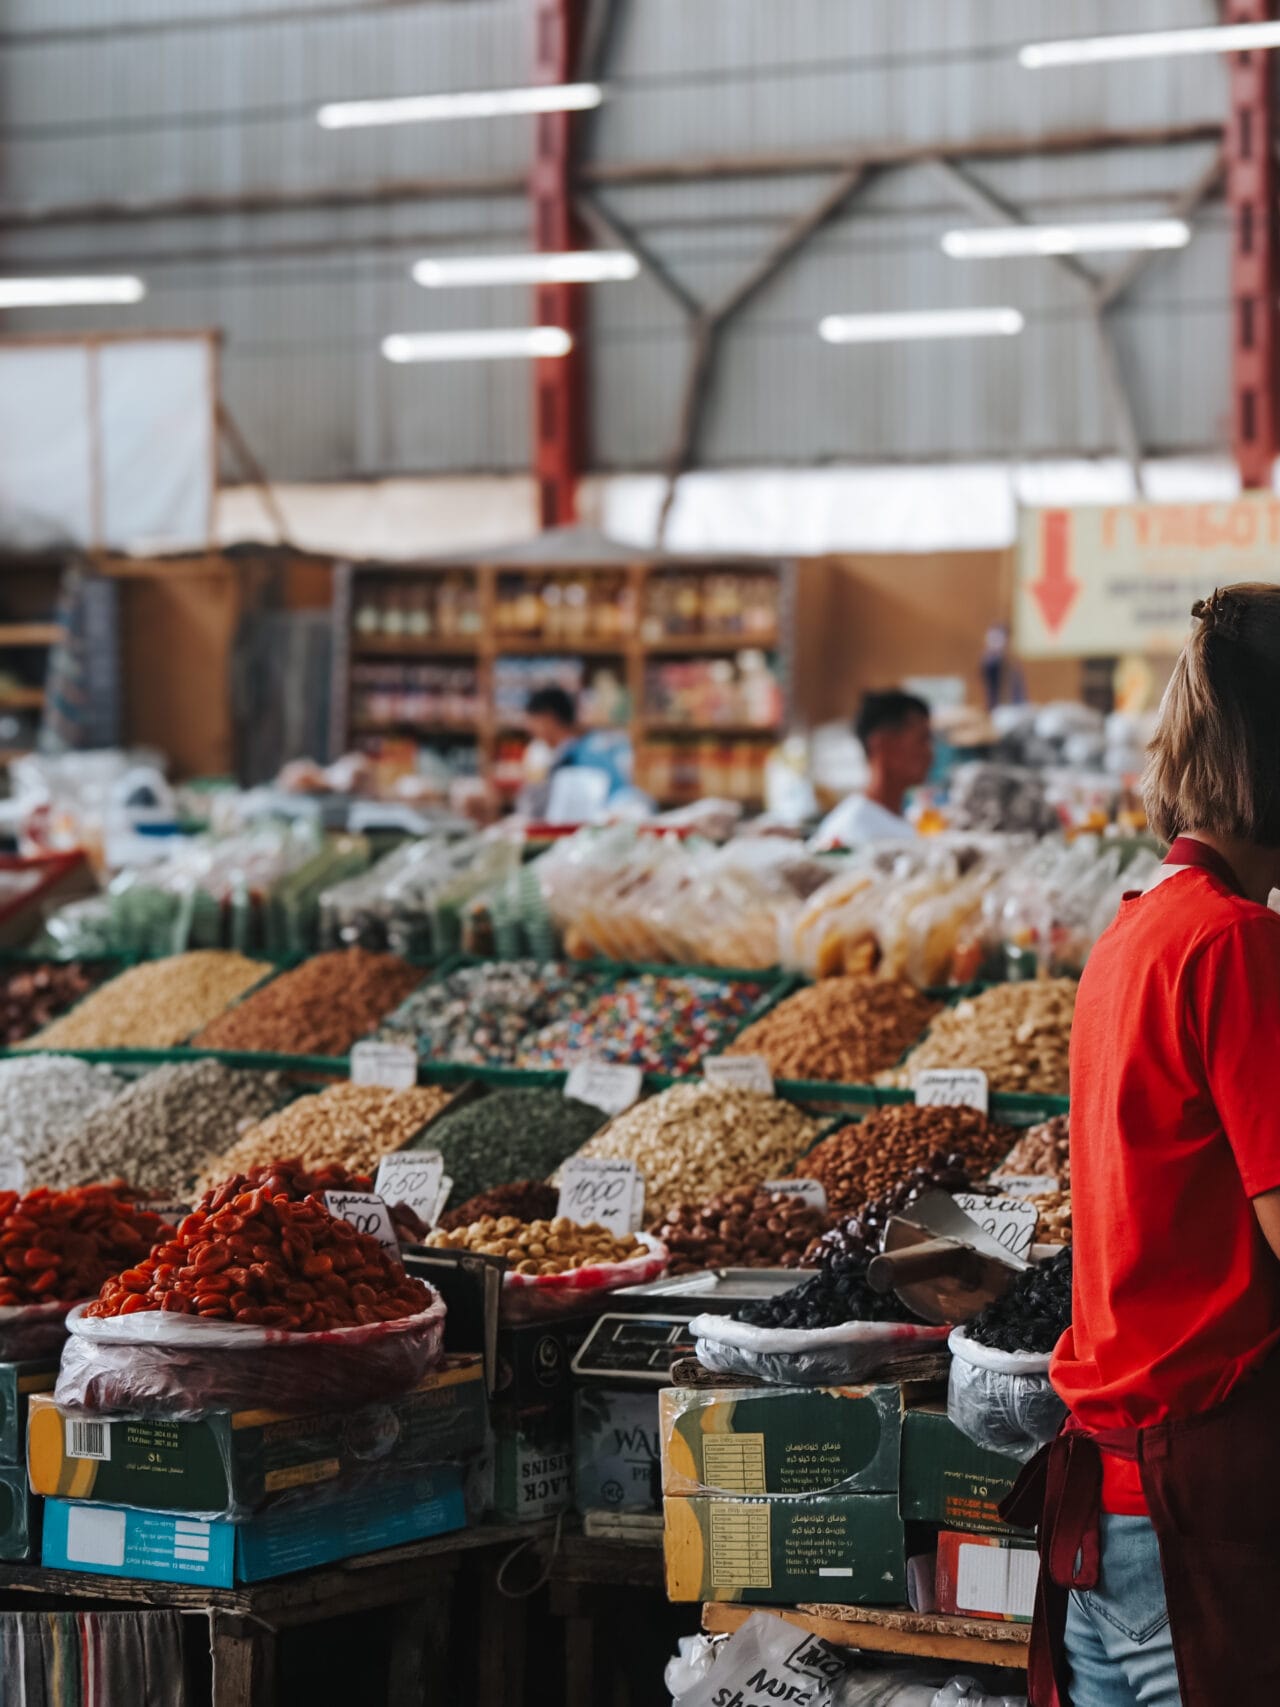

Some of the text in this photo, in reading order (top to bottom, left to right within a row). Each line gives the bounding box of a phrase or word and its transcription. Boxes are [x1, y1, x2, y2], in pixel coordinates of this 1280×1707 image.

[568, 1178, 626, 1208] 1000
[522, 1454, 573, 1478] AISINS
[523, 1475, 572, 1502] LACK
